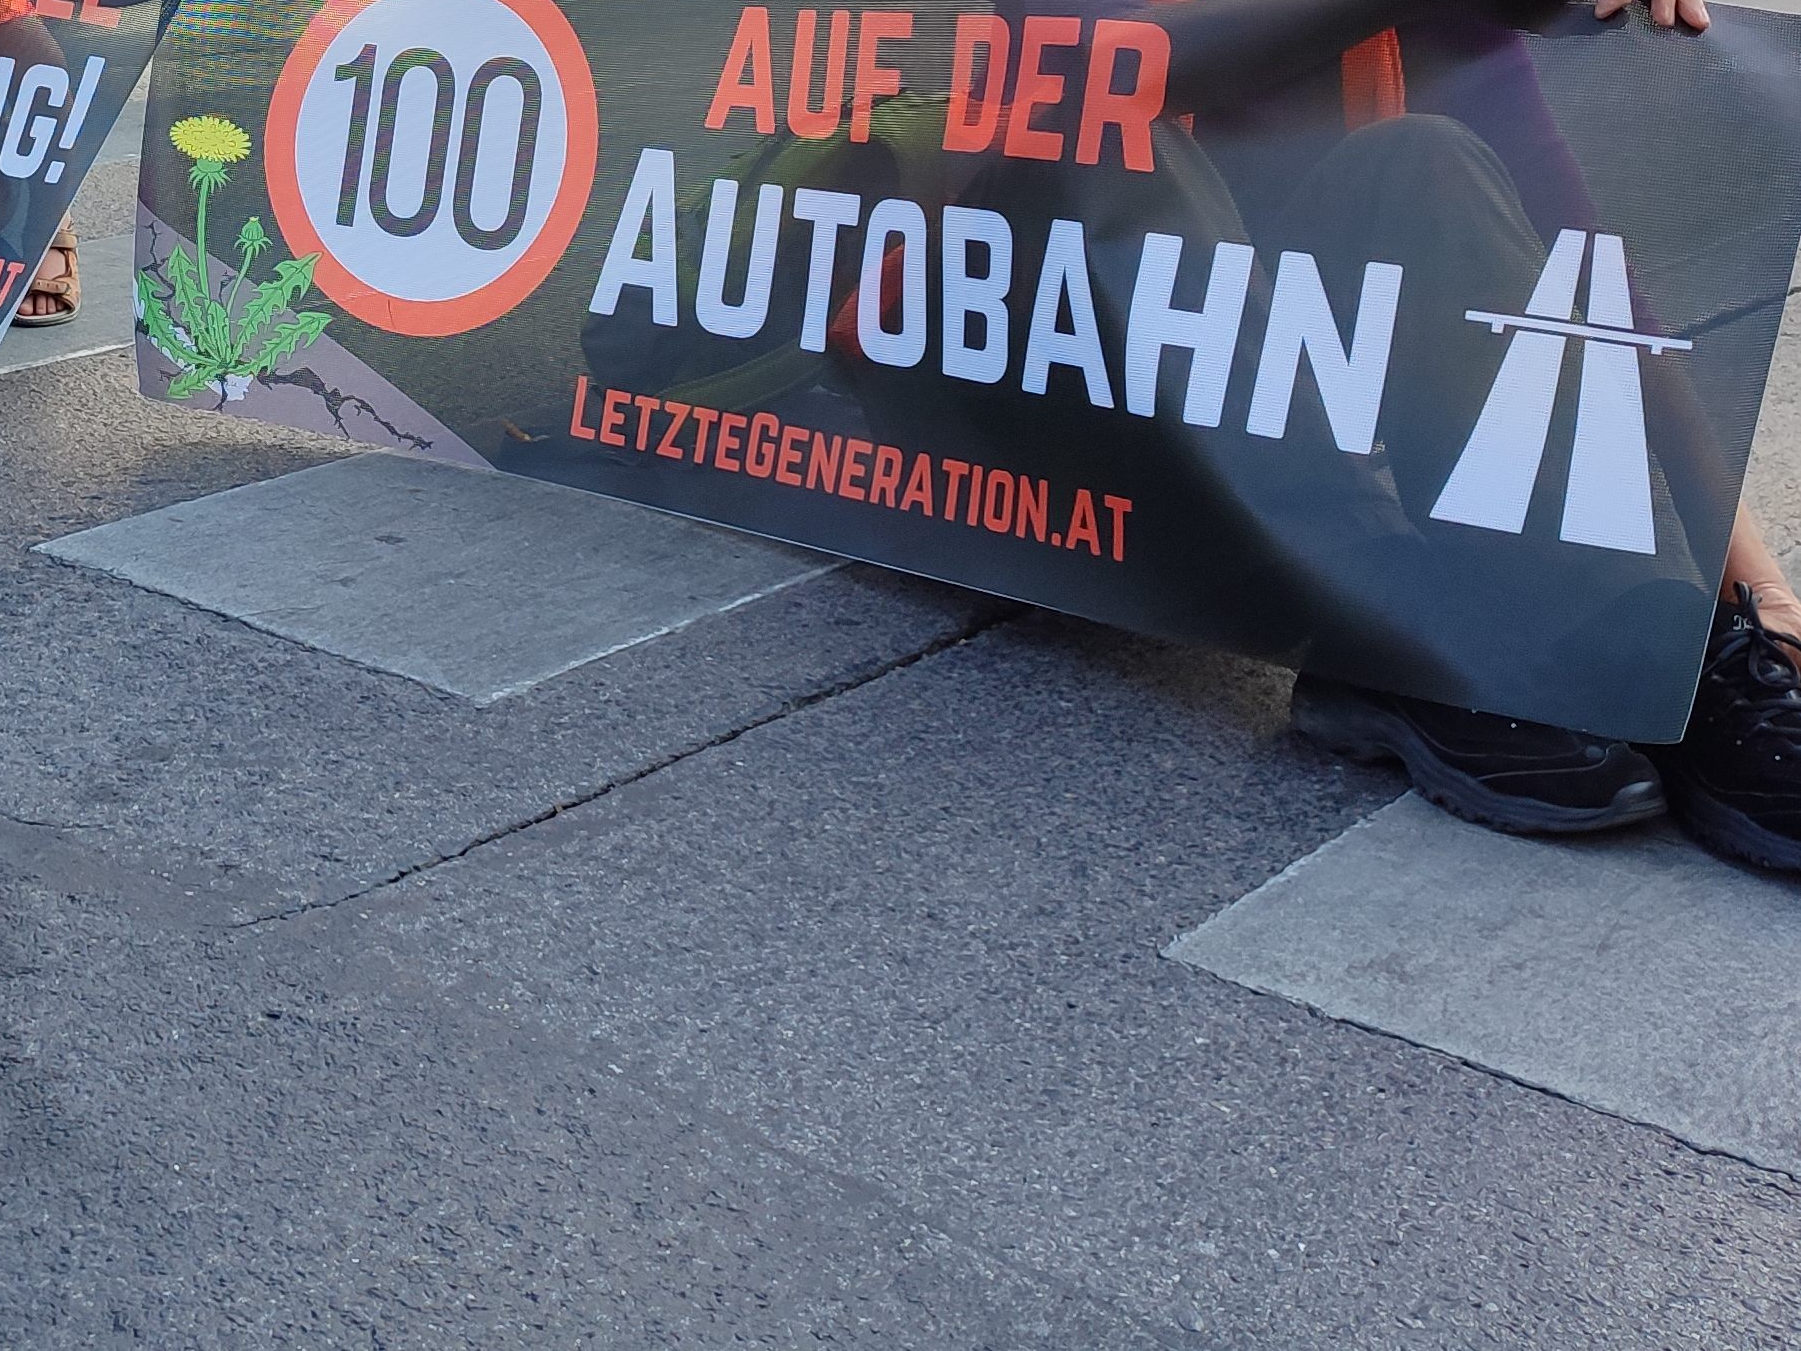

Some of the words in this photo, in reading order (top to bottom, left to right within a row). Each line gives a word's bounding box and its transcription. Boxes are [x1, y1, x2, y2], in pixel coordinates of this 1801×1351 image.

[334, 43, 542, 251] 100
[703, 7, 914, 144] AUF
[942, 14, 1172, 173] DER
[589, 148, 1404, 455] AUTOBAHN
[570, 375, 1133, 562] LETZTEGENERATION.AT
